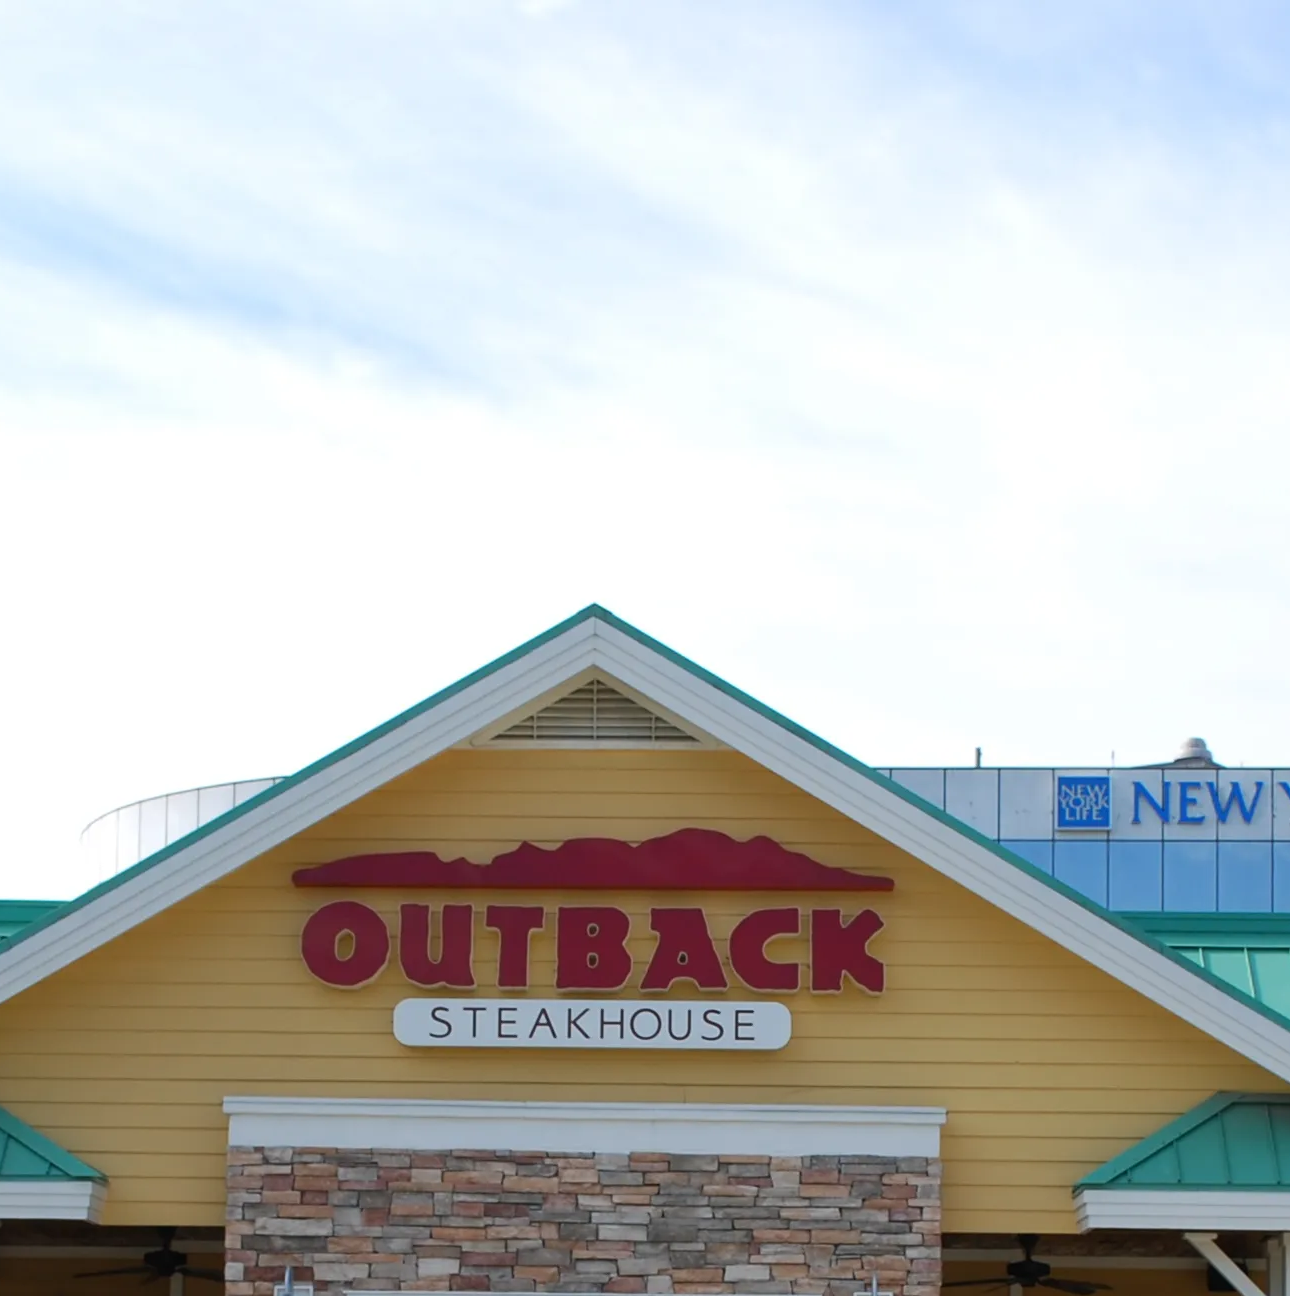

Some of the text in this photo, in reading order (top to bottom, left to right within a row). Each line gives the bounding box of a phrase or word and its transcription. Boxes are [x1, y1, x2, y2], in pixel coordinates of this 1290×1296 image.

[1061, 783, 1107, 796] NEW
[1059, 796, 1109, 809] YORK
[1065, 808, 1103, 821] LIFE
[1131, 781, 1264, 825] NEW
[301, 901, 886, 994] OUTBACK
[428, 1006, 757, 1042] STEAKHOUSE
